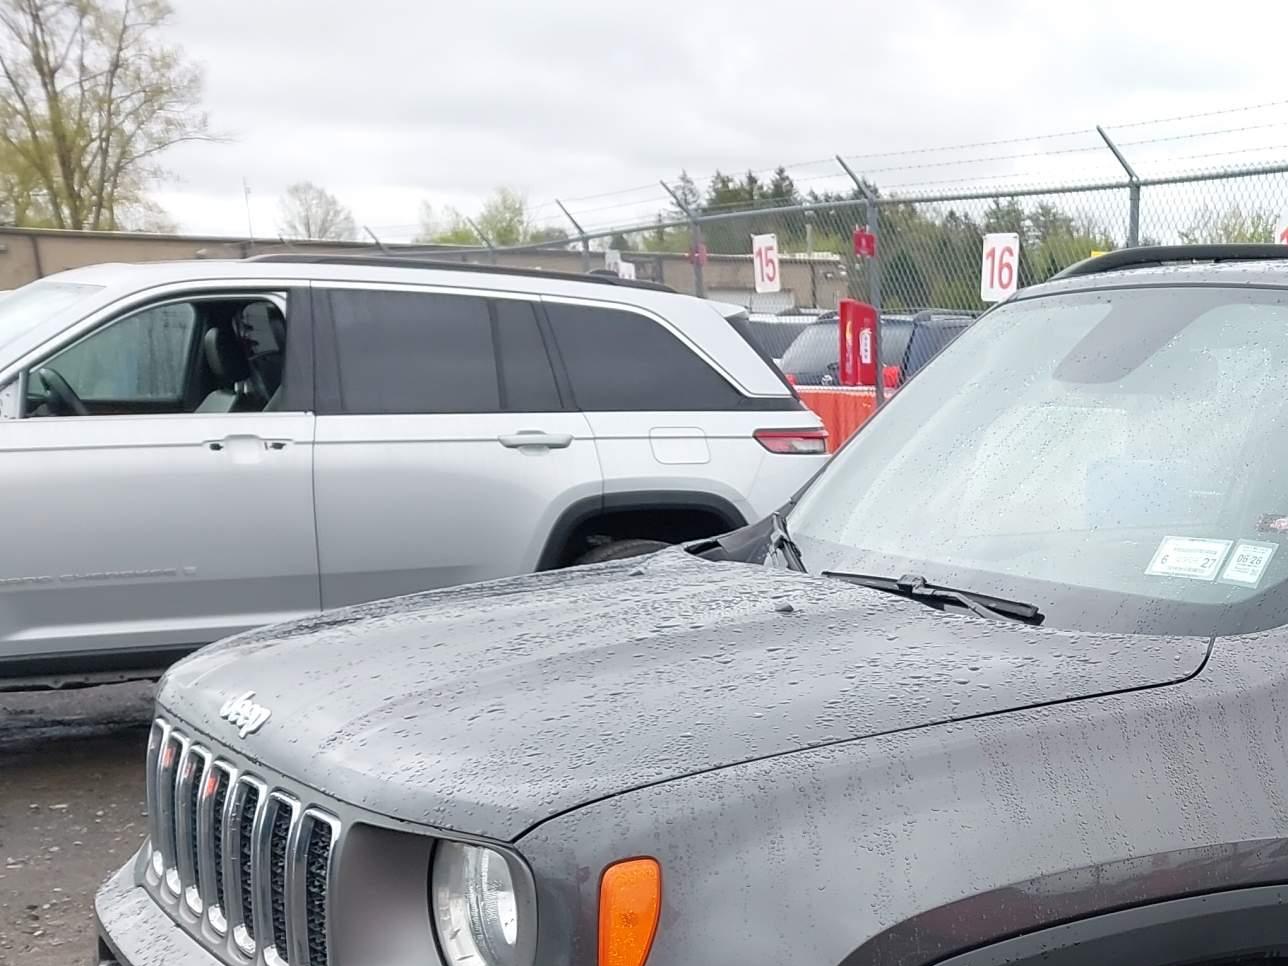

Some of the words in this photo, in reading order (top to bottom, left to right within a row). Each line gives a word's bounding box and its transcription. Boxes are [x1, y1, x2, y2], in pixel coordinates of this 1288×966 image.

[755, 246, 776, 282] 15
[986, 246, 1014, 289] 16
[1200, 557, 1217, 569] 27
[219, 689, 272, 740] Jeep
